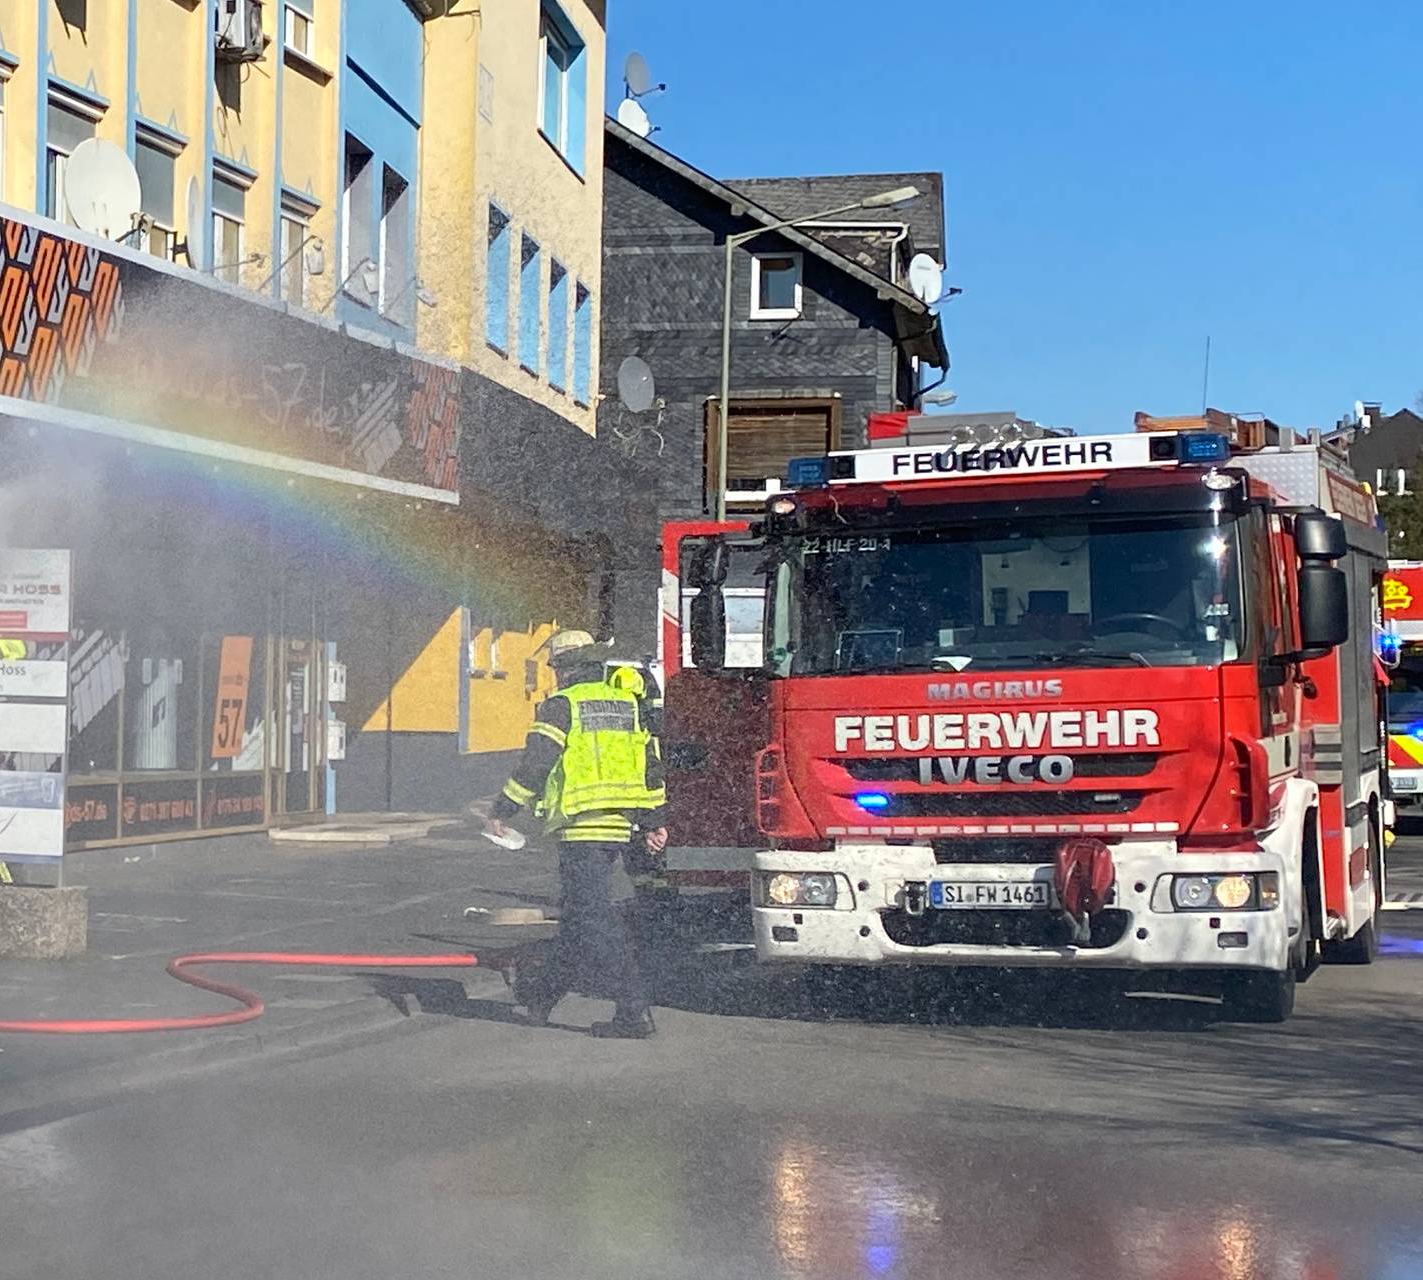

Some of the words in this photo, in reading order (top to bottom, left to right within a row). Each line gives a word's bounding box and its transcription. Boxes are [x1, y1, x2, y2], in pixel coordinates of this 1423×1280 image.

[892, 441, 1113, 475] FEUERWEHR
[927, 679, 1063, 700] MAGIRUS
[833, 709, 1161, 751] FEUERWEHR
[918, 754, 1074, 785] IVECO
[944, 885, 964, 903] SI
[975, 885, 997, 903] FW
[1002, 886, 1045, 903] 1461
